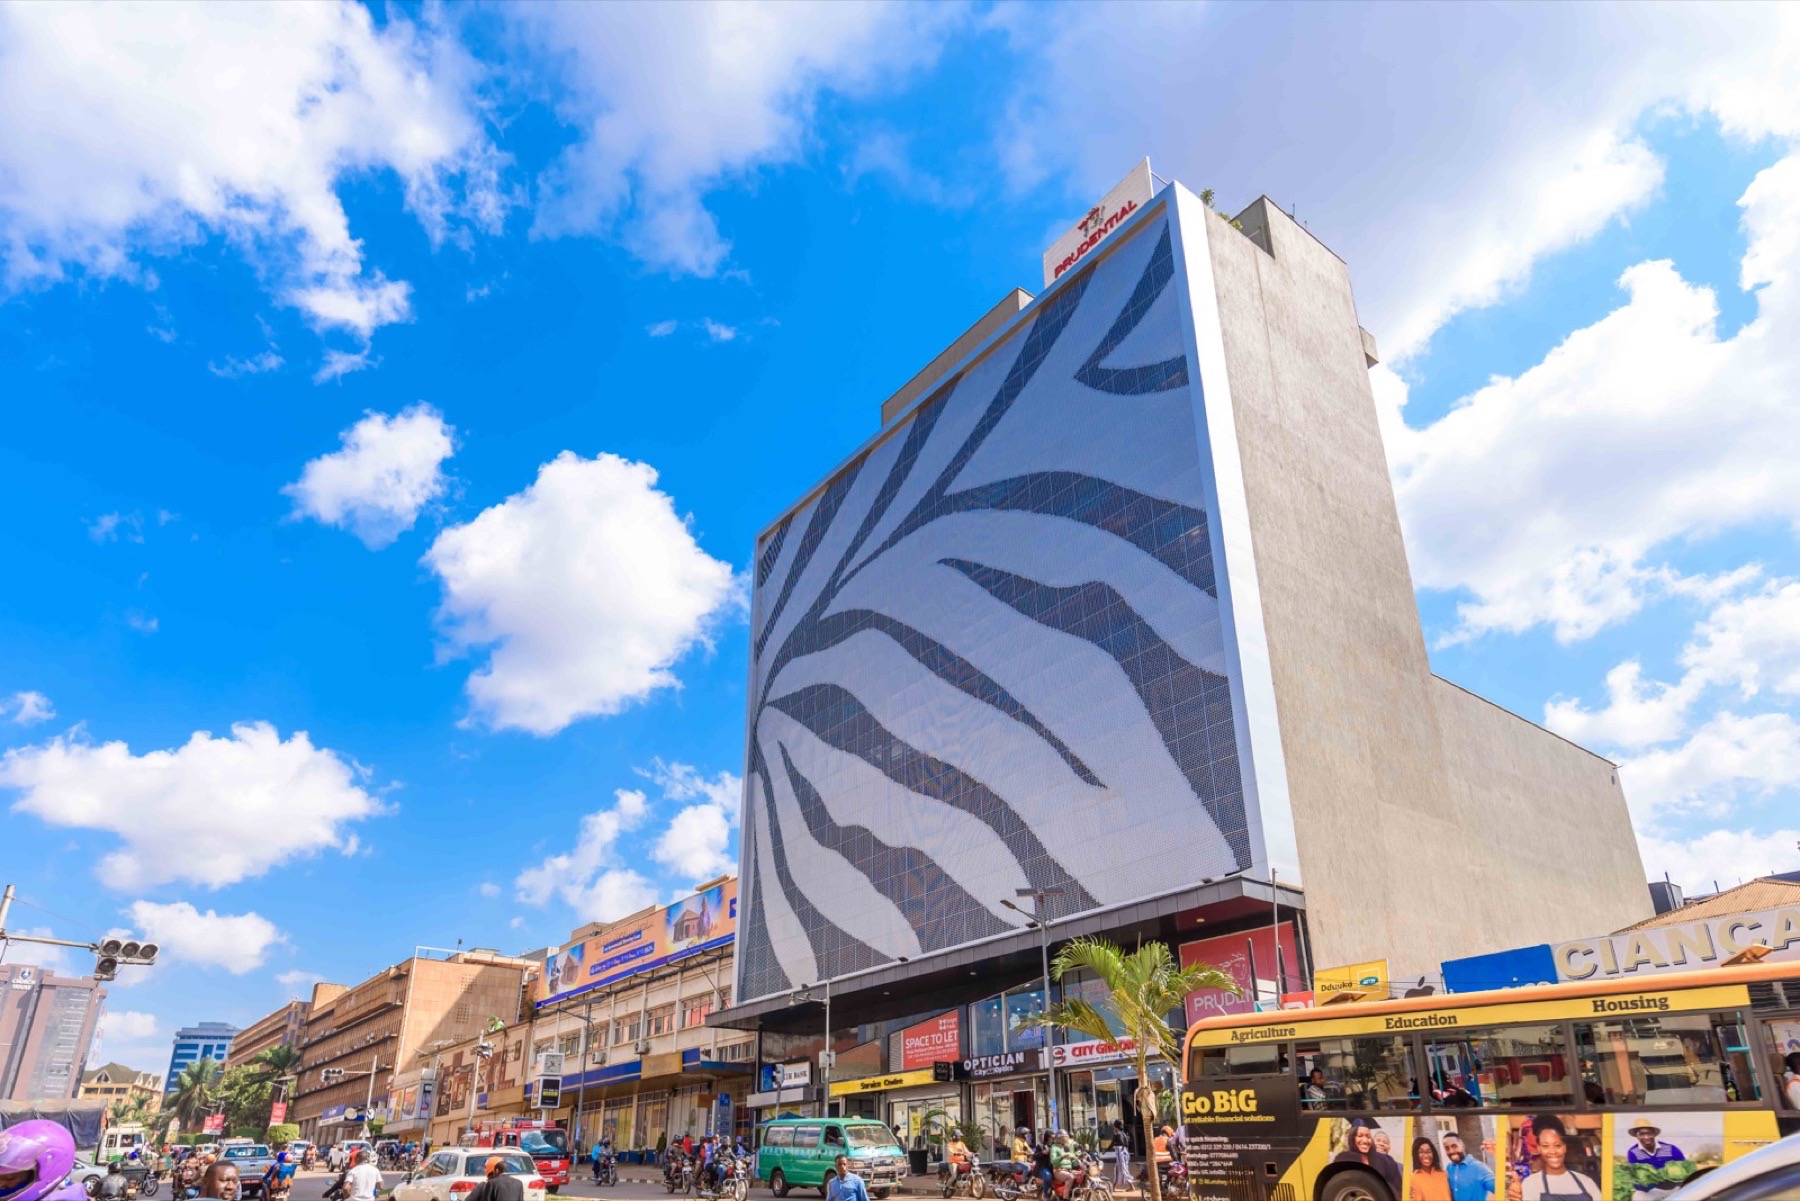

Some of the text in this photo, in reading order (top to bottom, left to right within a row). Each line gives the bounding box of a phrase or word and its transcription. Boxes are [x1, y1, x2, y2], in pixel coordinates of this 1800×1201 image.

[1054, 200, 1137, 279] PRUDENTIAL
[1194, 988, 1254, 1011] PRUDEN
[1592, 995, 1669, 1013] Housing
[1385, 1014, 1458, 1029] Education
[905, 1035, 930, 1049] SPACE
[931, 1033, 943, 1045] TO
[943, 1030, 958, 1043] LET
[1231, 1026, 1296, 1042] Agriculture
[1071, 1045, 1094, 1057] CITY
[963, 1052, 1025, 1071] OPTICIAN
[860, 1081, 881, 1090] Service
[1182, 1089, 1257, 1114] Go BiG
